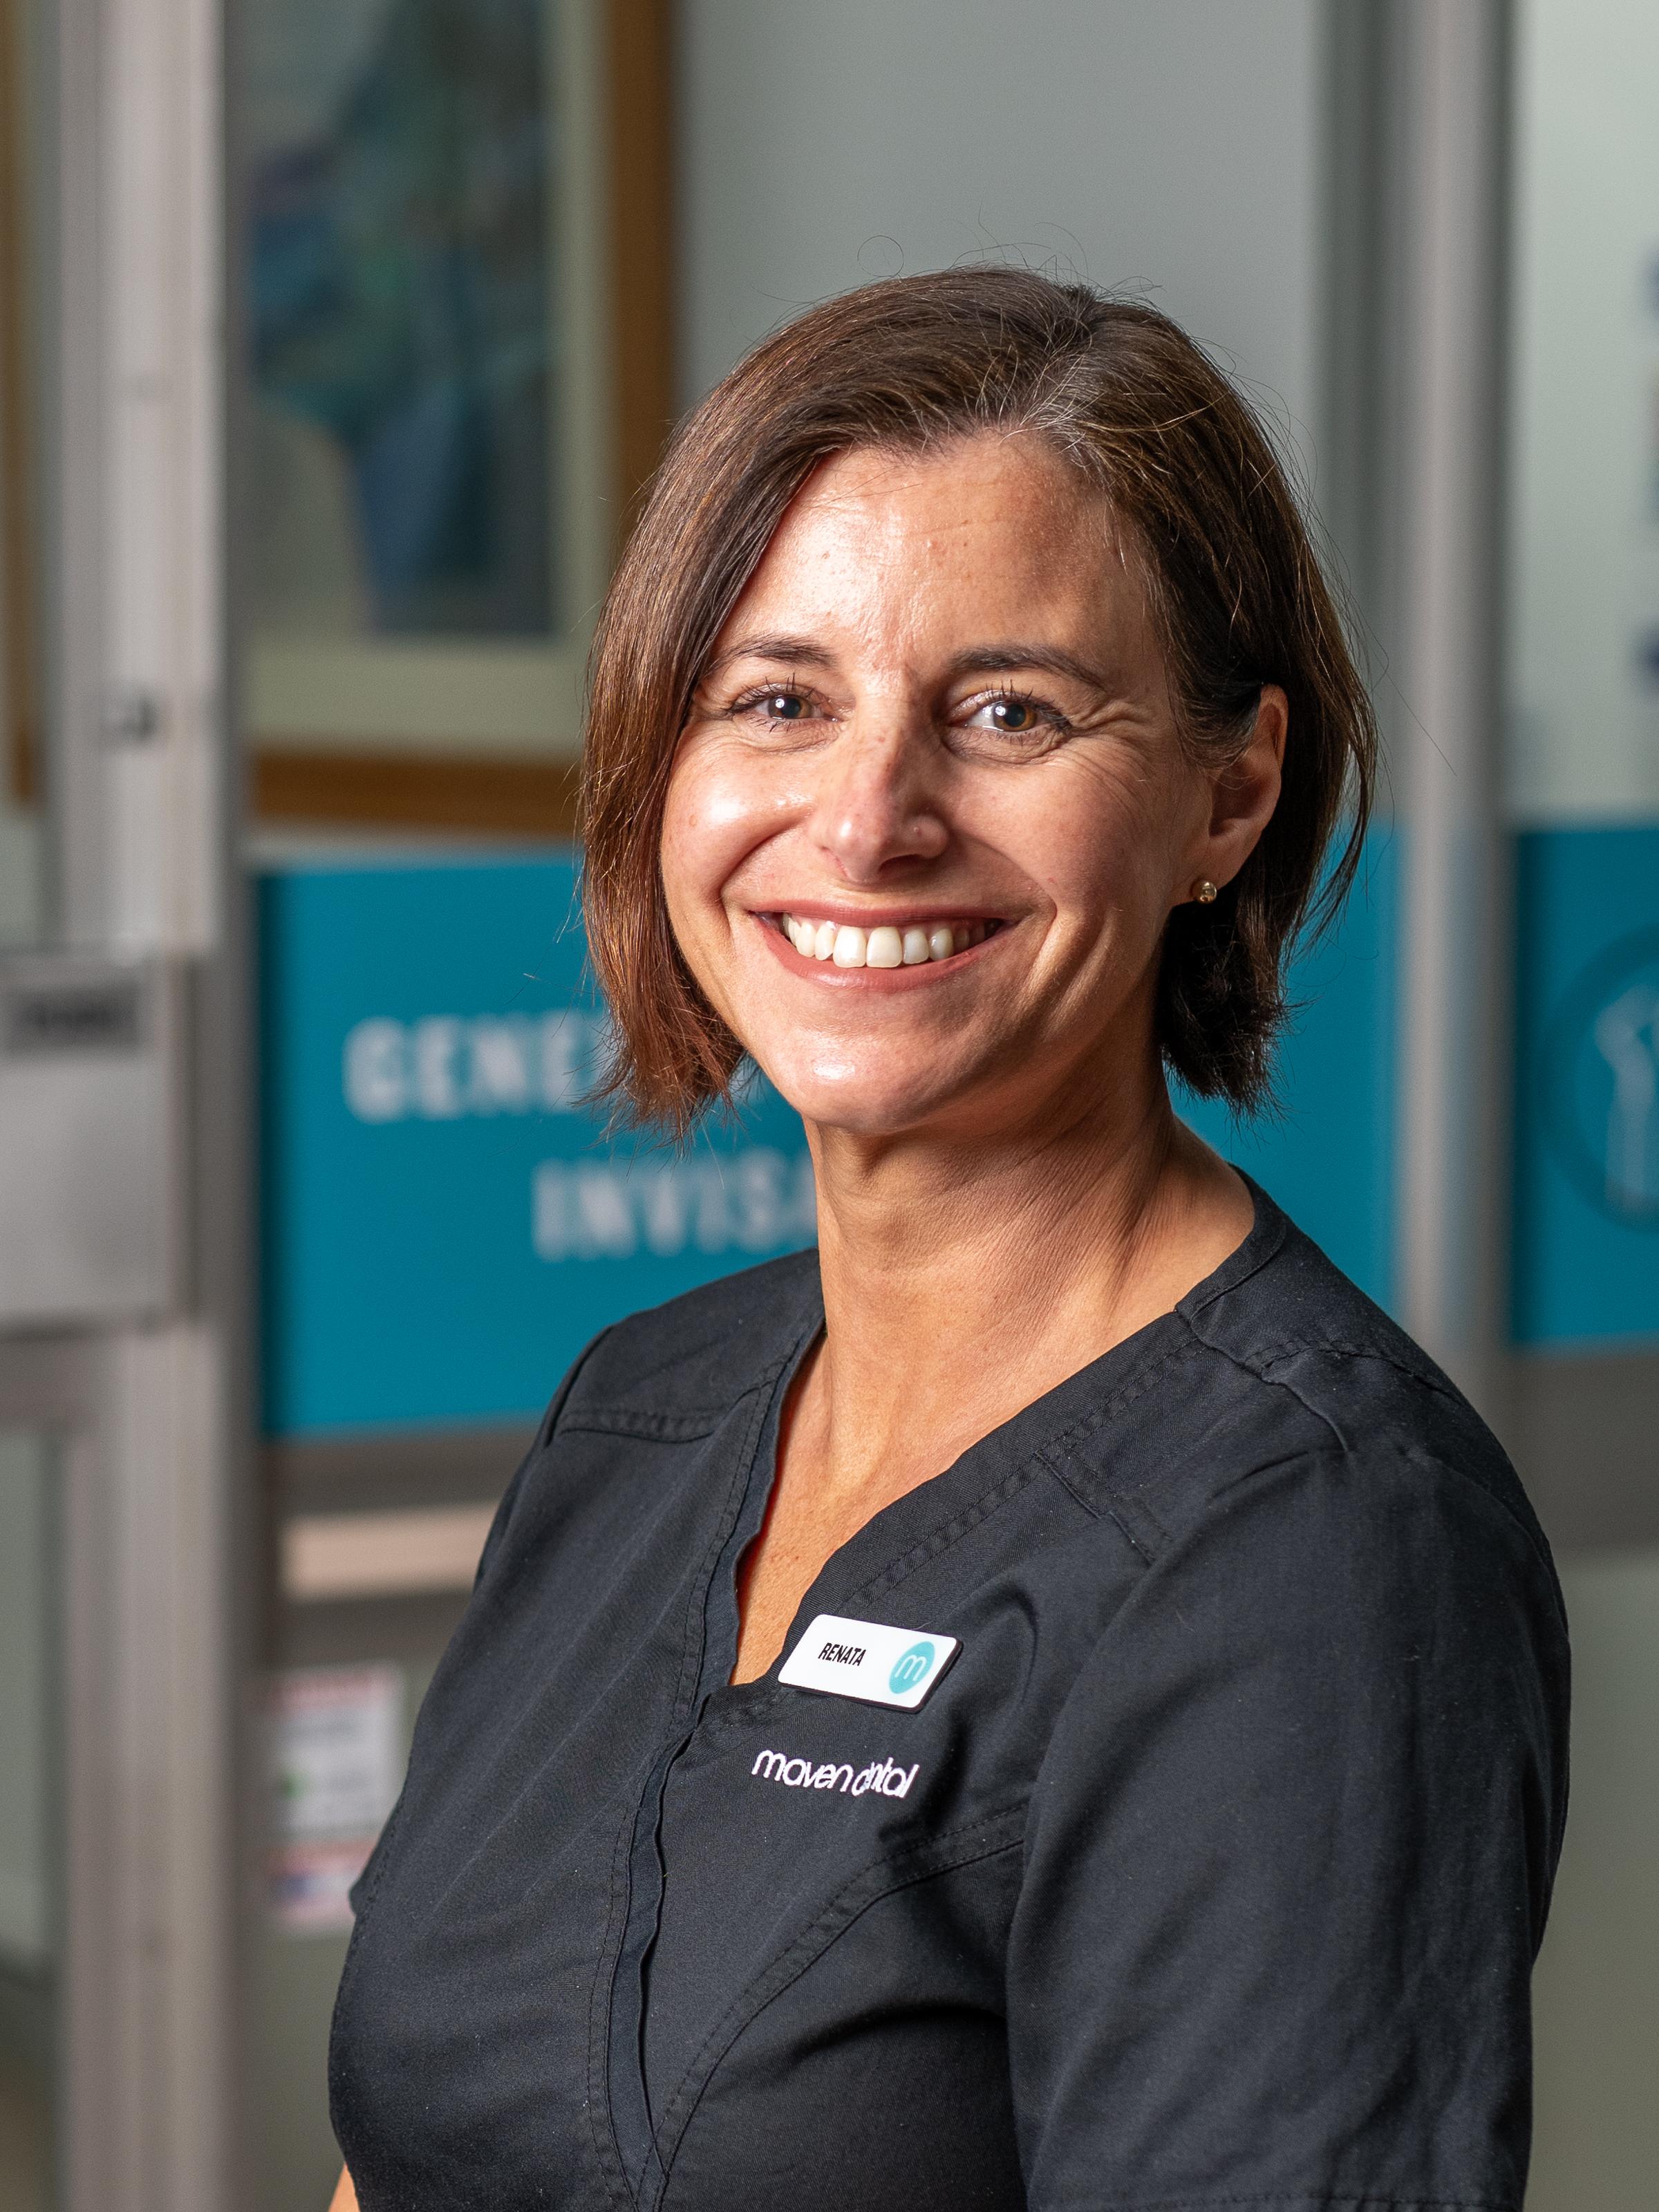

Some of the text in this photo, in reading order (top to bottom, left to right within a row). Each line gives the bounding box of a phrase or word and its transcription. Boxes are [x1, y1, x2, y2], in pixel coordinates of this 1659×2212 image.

[341, 1010, 626, 1124] GENE
[818, 1642, 866, 1667] RENATA
[751, 1750, 854, 1792] maven
